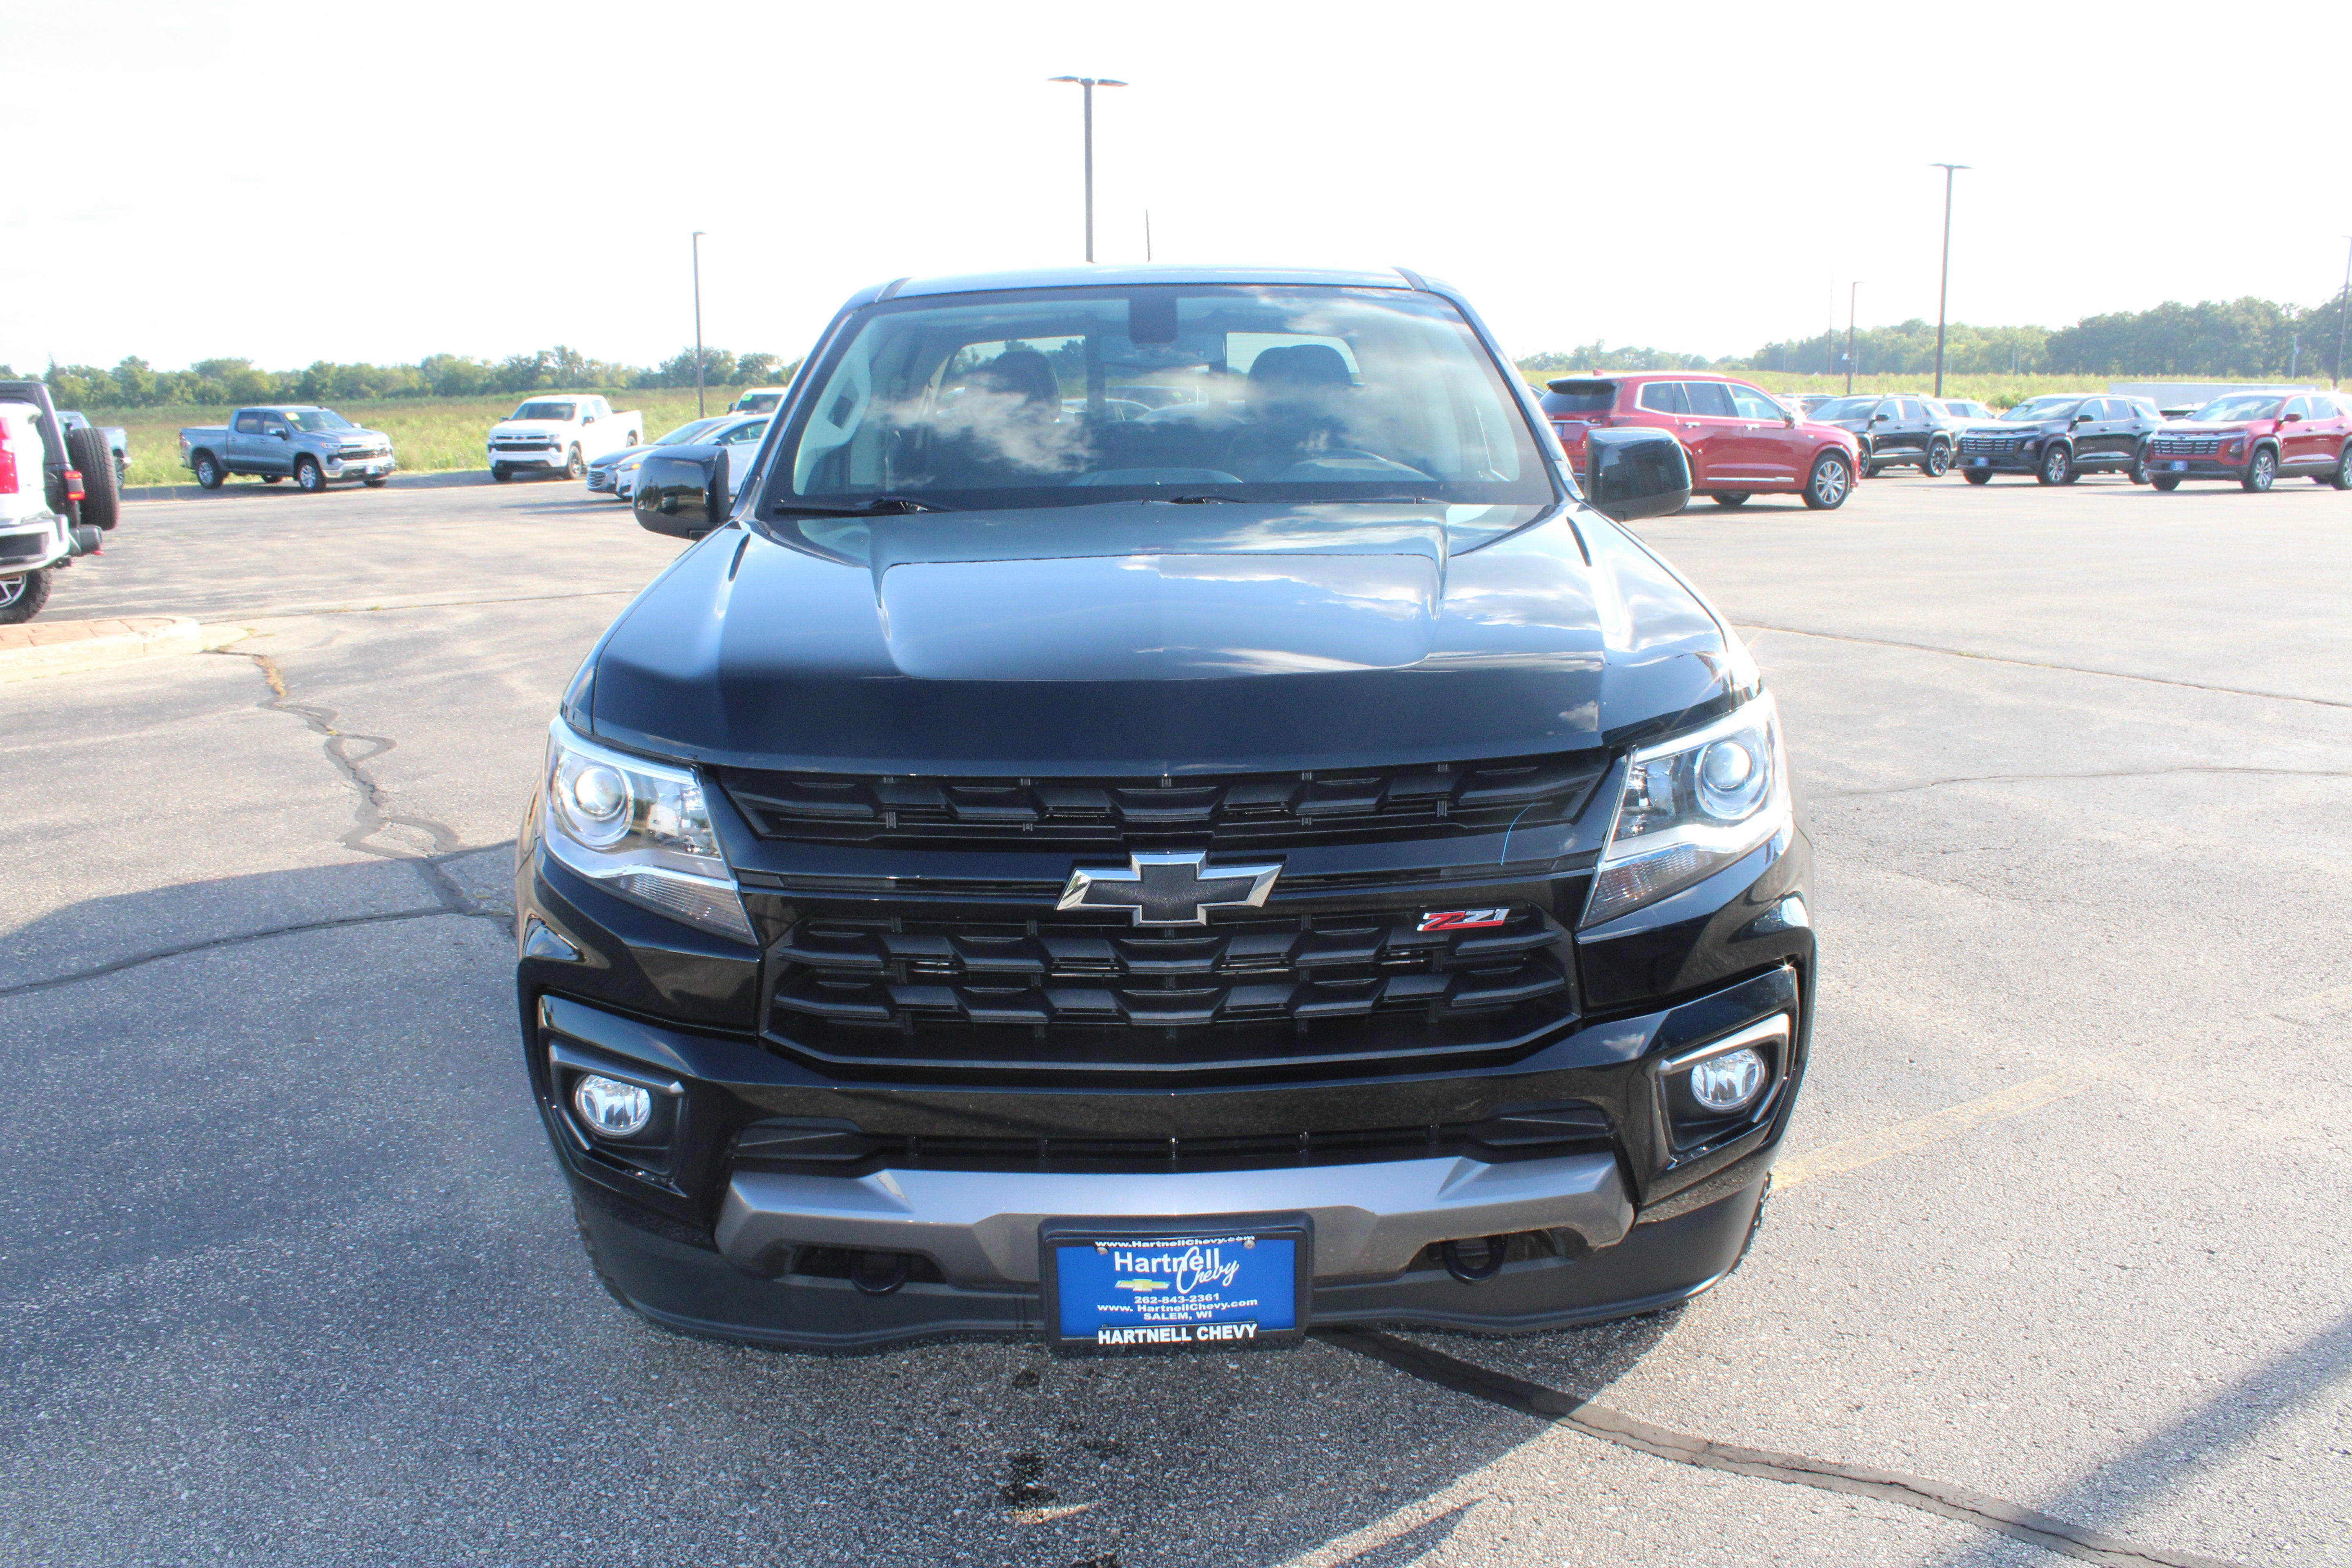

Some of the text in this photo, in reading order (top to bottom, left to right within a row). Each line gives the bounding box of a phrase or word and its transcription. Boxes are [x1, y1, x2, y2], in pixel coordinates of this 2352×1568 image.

[1417, 908, 1509, 931] Z71
[1095, 1235, 1255, 1247] www.HartnellChevy.com
[1114, 1247, 1219, 1273] Hartnell
[1176, 1245, 1240, 1294] Chevy
[1134, 1293, 1219, 1304] 262-843-2361
[1144, 1310, 1212, 1321] SALEM, WI
[1098, 1323, 1258, 1345] HARTNELL CHEVY
